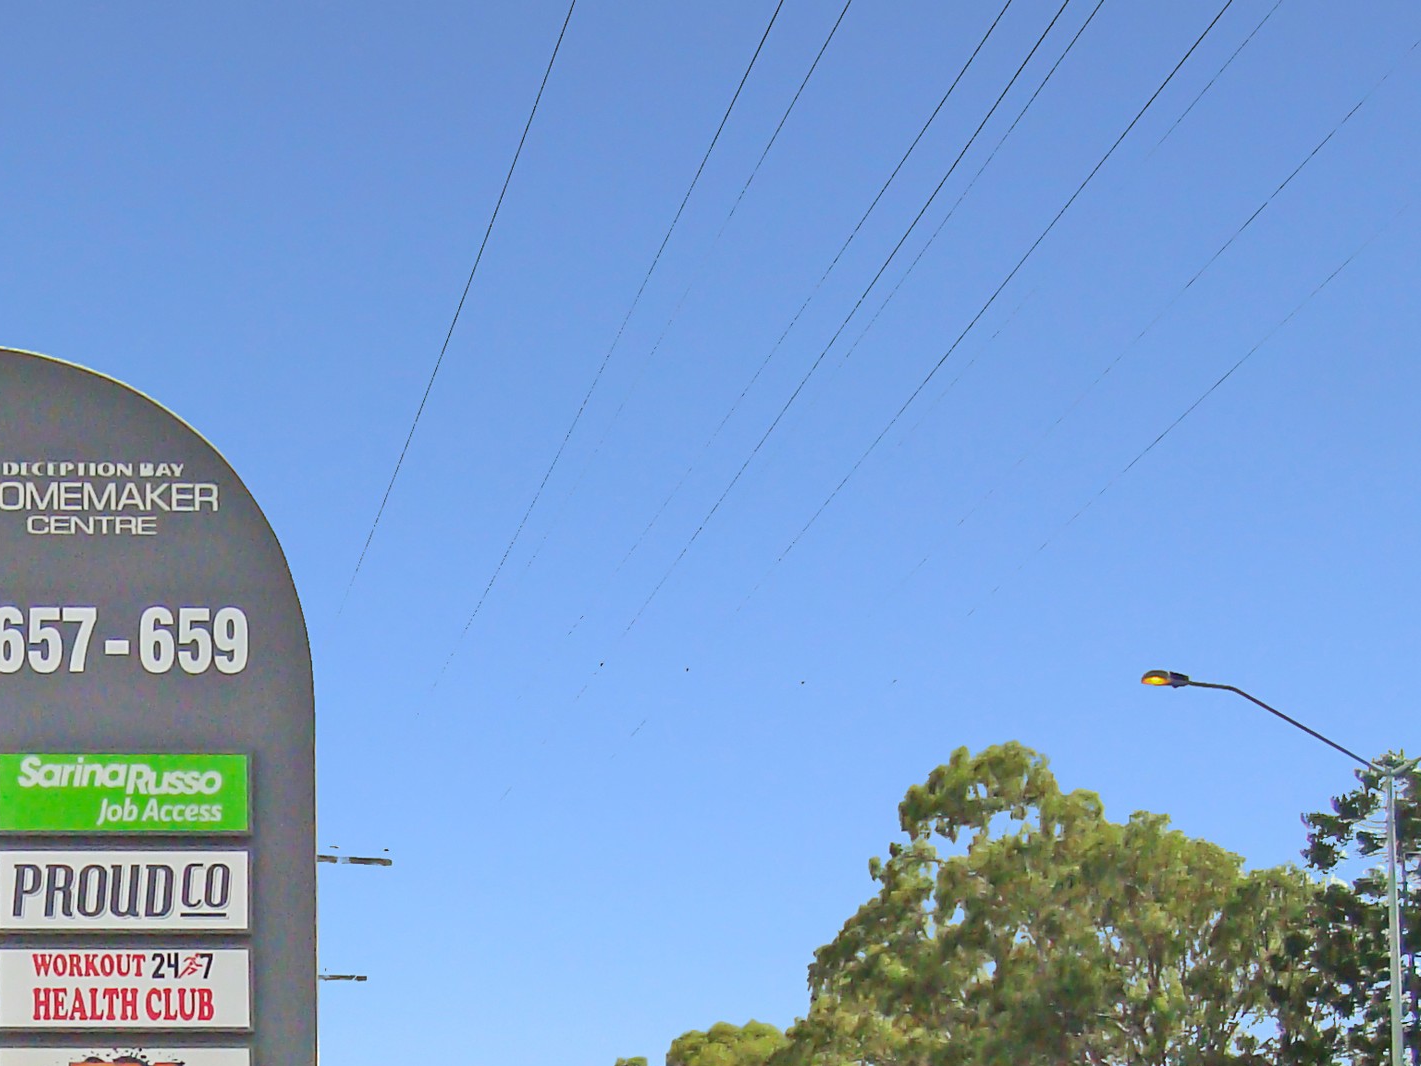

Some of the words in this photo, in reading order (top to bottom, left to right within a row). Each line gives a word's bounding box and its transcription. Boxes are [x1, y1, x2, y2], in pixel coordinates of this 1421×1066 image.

[140, 462, 184, 477] BAY
[26, 515, 158, 535] CENTRE
[96, 798, 138, 826] Job
[141, 798, 223, 822] Access
[32, 953, 146, 977] WORKOUT
[32, 988, 139, 1021] HEALTH
[145, 988, 215, 1021] CLUB
